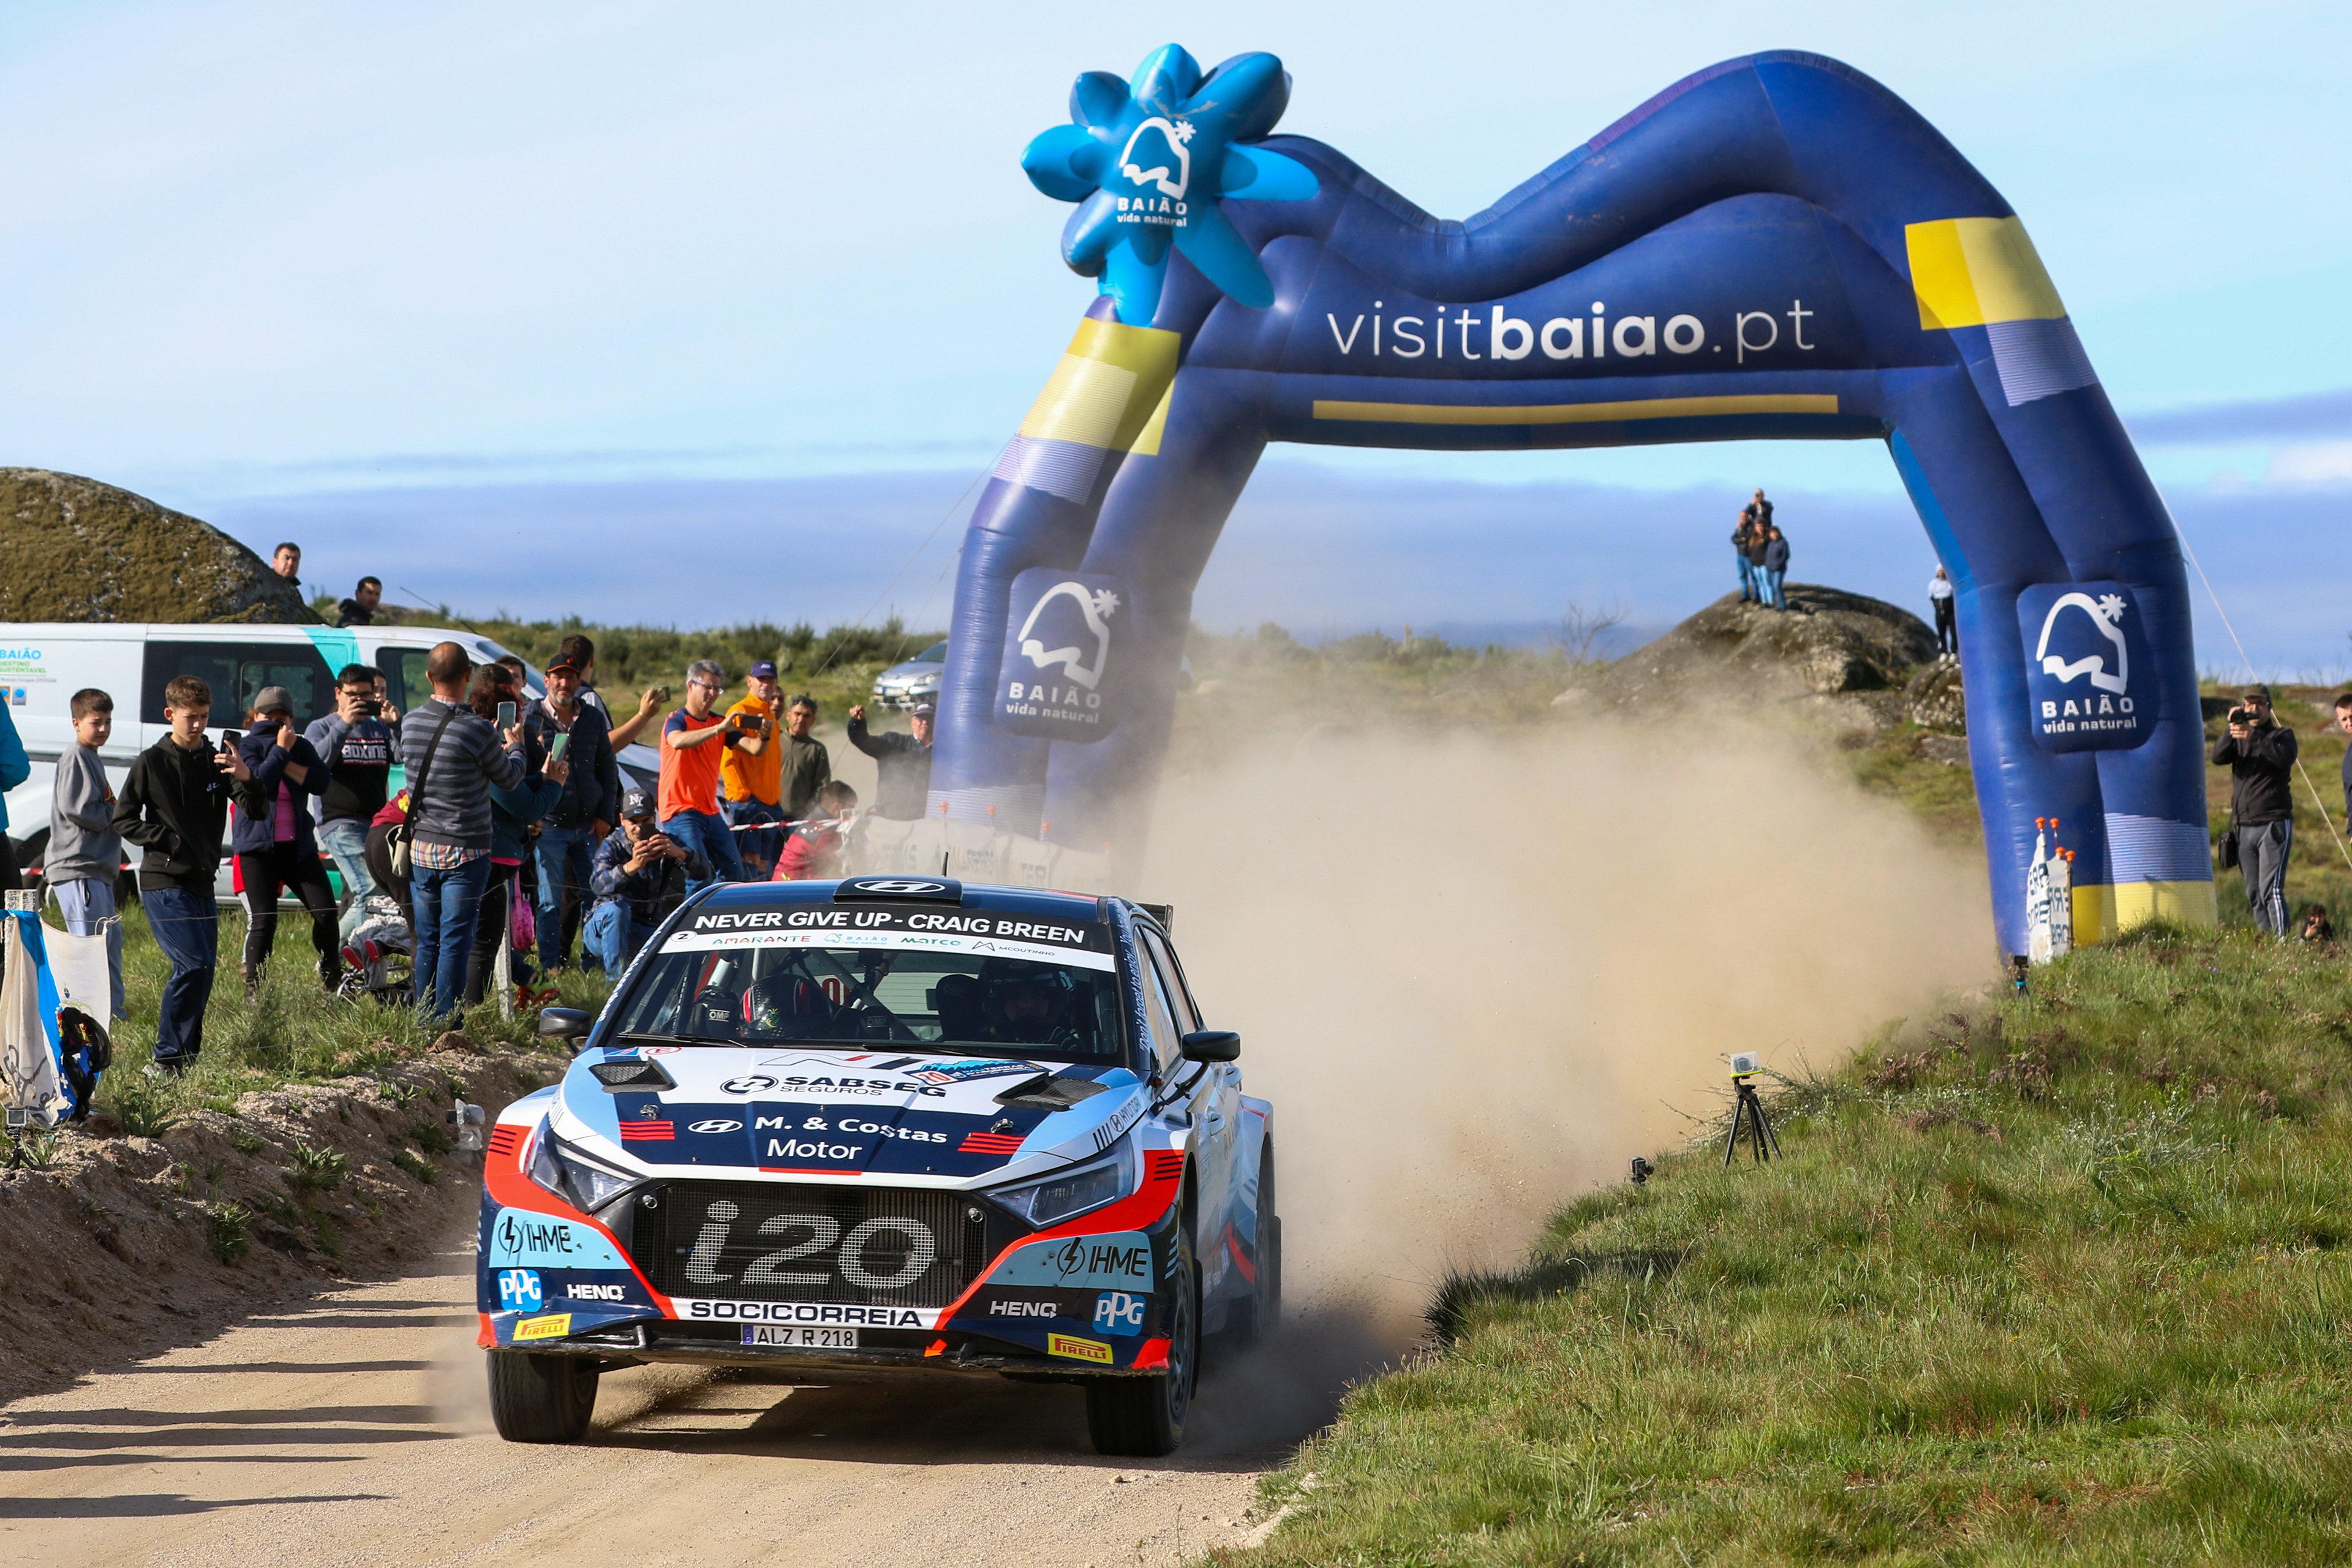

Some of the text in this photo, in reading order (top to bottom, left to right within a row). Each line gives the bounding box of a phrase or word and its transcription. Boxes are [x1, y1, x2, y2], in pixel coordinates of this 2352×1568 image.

[1118, 197, 1187, 214] BAIÃO
[1117, 213, 1186, 227] vida natural
[1327, 300, 1815, 363] visitbaiao.pt
[0, 647, 42, 660] BAIÃO
[1009, 682, 1101, 709] BAIÃO
[1006, 703, 1099, 724] vida natural
[2041, 694, 2134, 718] BAIÃO
[2043, 716, 2137, 734] vida natural
[341, 744, 386, 760] BOXING
[629, 793, 644, 807] NY
[694, 913, 783, 929] NEVER
[788, 911, 850, 927] GIVE
[854, 912, 892, 927] UP
[907, 913, 990, 933] CRAIG
[995, 921, 1085, 943] BREEN
[712, 935, 812, 945] AMARANTE
[999, 946, 1055, 957] MCOUTINHO
[709, 1011, 729, 1020] OMP
[783, 1076, 946, 1098] SABSEG
[918, 1072, 952, 1083] 10
[780, 1086, 883, 1096] SEGUROS
[754, 1117, 948, 1143] M. & Costas
[767, 1139, 862, 1159] Motor
[526, 1223, 573, 1253] IHME
[684, 1200, 935, 1289] i20
[1088, 1245, 1148, 1276] IHME
[499, 1269, 541, 1304] PPG
[691, 1302, 922, 1327] SOCICORREIA
[1095, 1292, 1144, 1327] PPG
[521, 1319, 565, 1336] PIRELLI
[757, 1327, 793, 1344] ALZ
[802, 1329, 814, 1346] R
[821, 1330, 853, 1346] 218
[1054, 1338, 1106, 1359] PIRELLI
